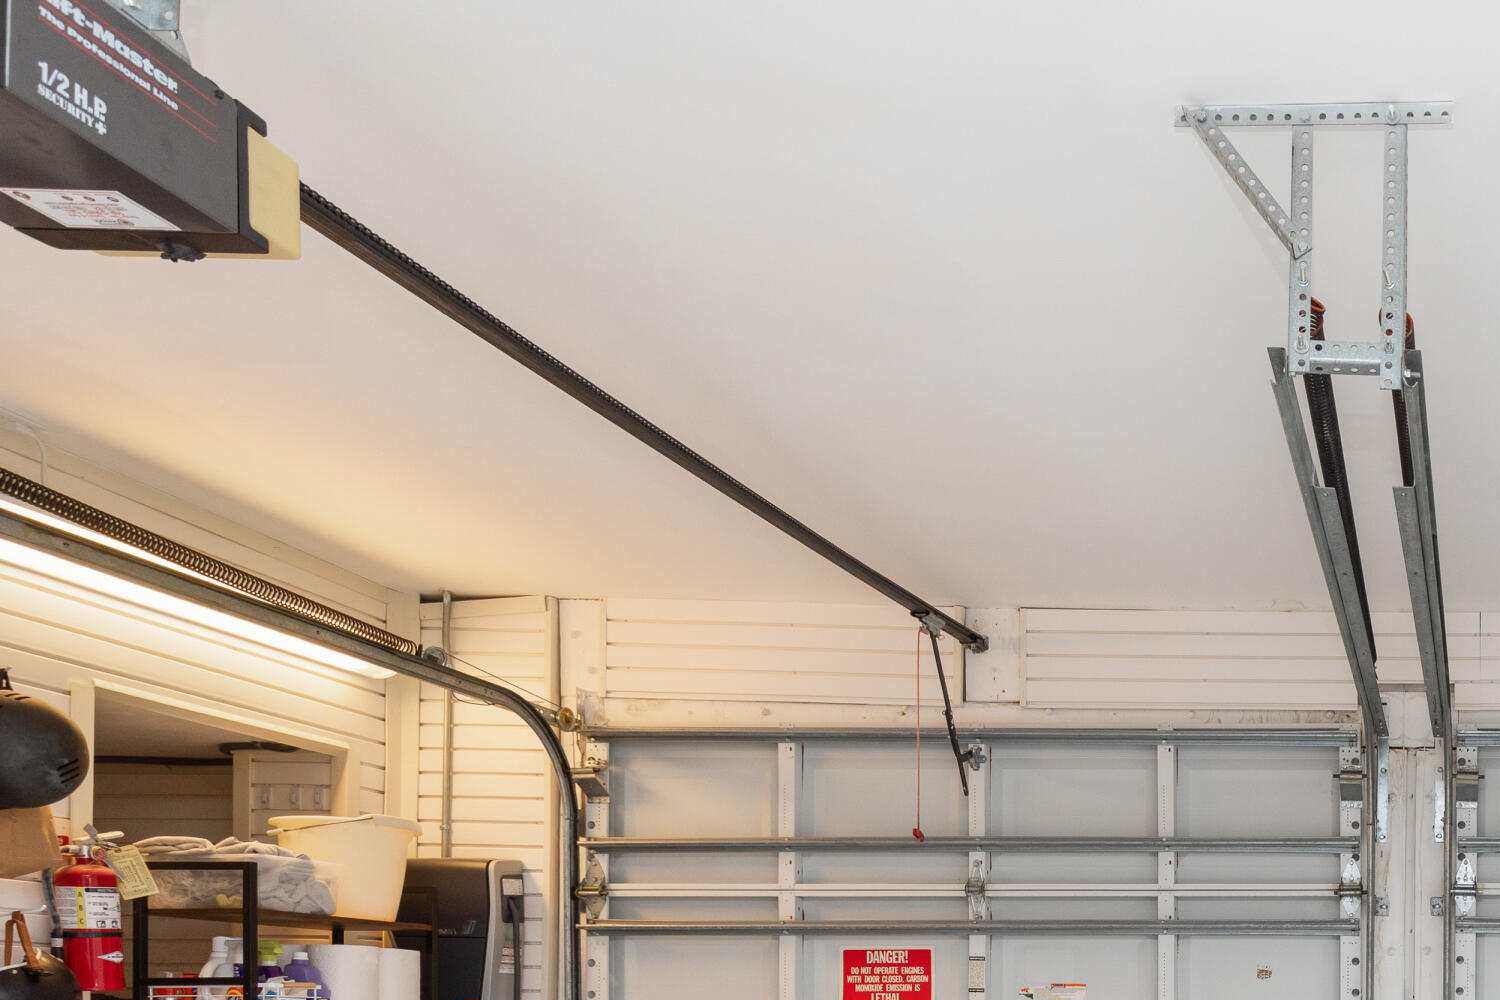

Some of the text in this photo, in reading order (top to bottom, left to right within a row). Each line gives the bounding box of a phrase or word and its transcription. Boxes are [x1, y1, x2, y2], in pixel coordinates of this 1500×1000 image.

[38, 5, 179, 111] The Professional Line
[38, 61, 70, 99] 1/2
[866, 950, 908, 964] DANGER!
[850, 966, 924, 974] DO NOT OPERATE ENGINES
[846, 975, 929, 983] WITH DOOR CLOSED. CARBON
[855, 984, 920, 992] MONOXIDE EMISSION IS
